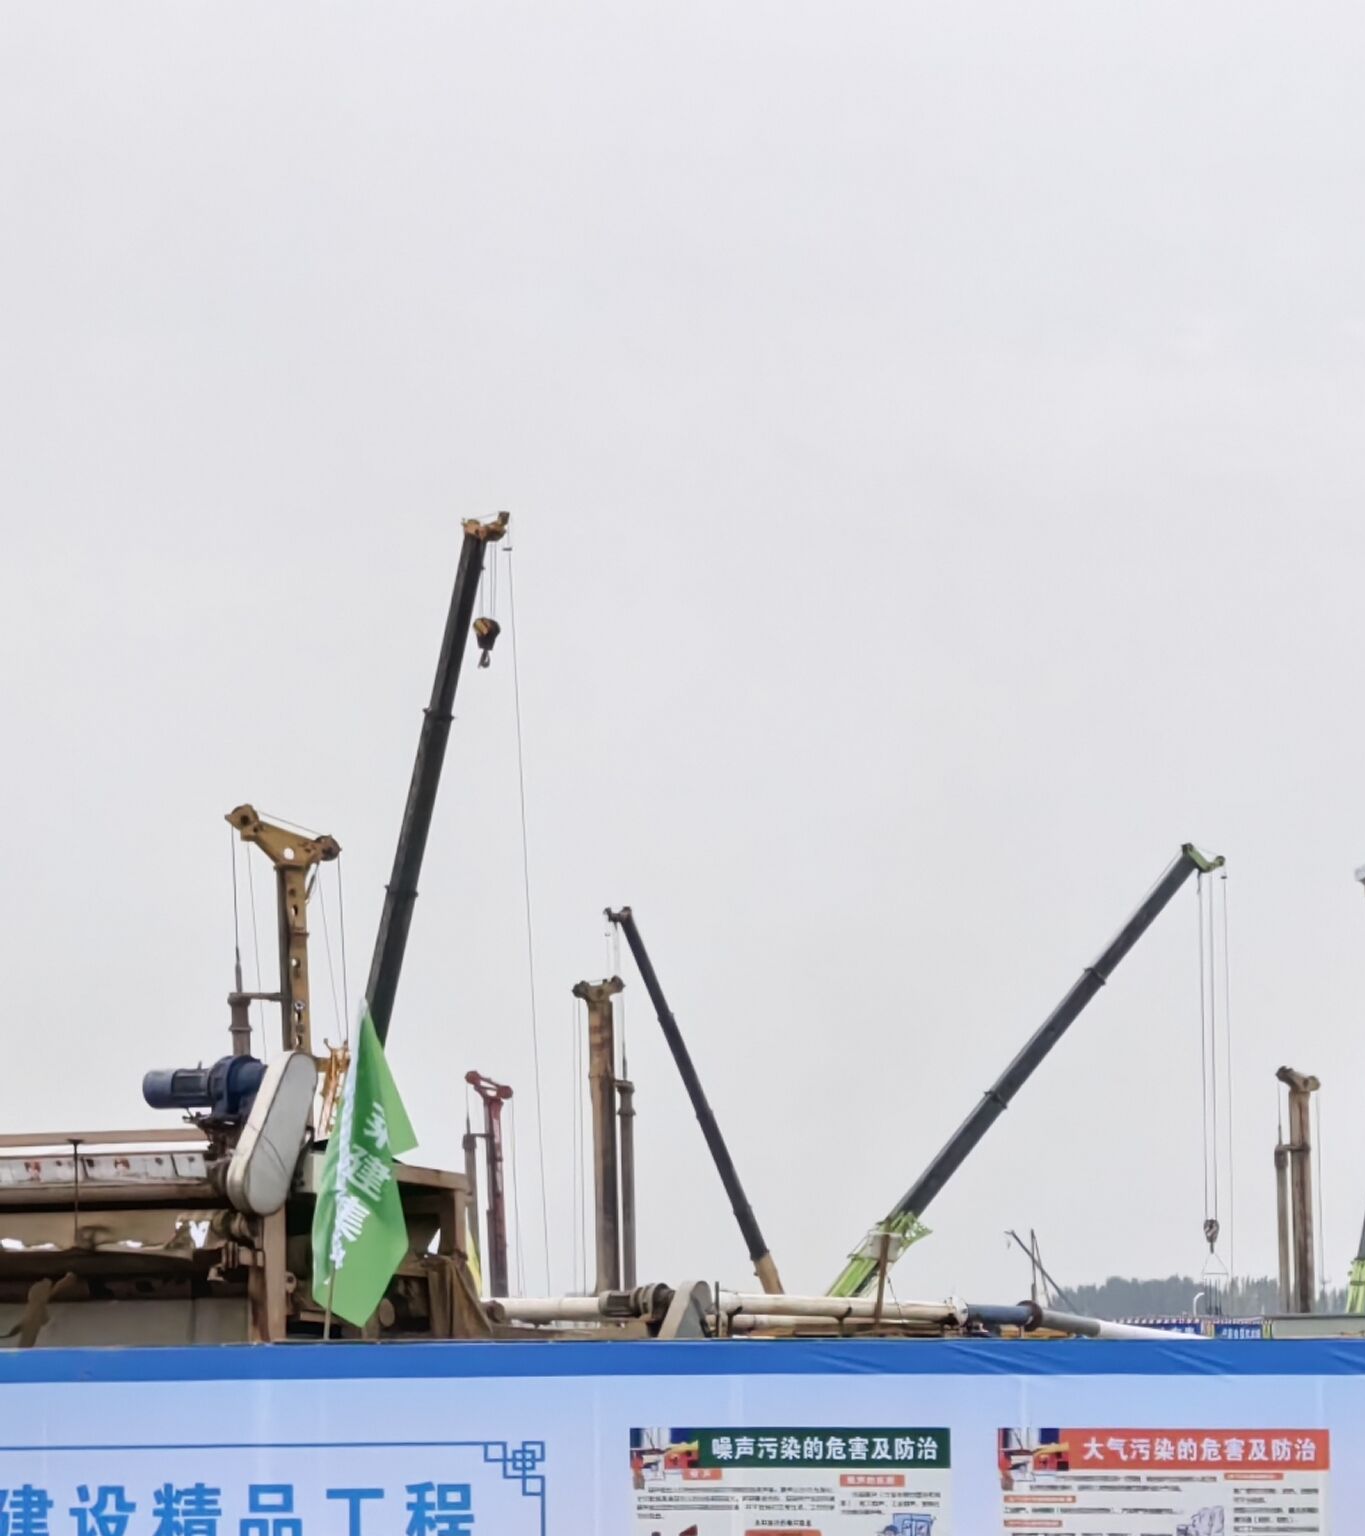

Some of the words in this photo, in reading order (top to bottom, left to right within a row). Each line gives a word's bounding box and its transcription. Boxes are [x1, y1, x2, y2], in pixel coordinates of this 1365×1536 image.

[711, 1436, 938, 1460] 噪声污染的危害及防治
[1083, 1437, 1316, 1461] 大气污染的危害及防治
